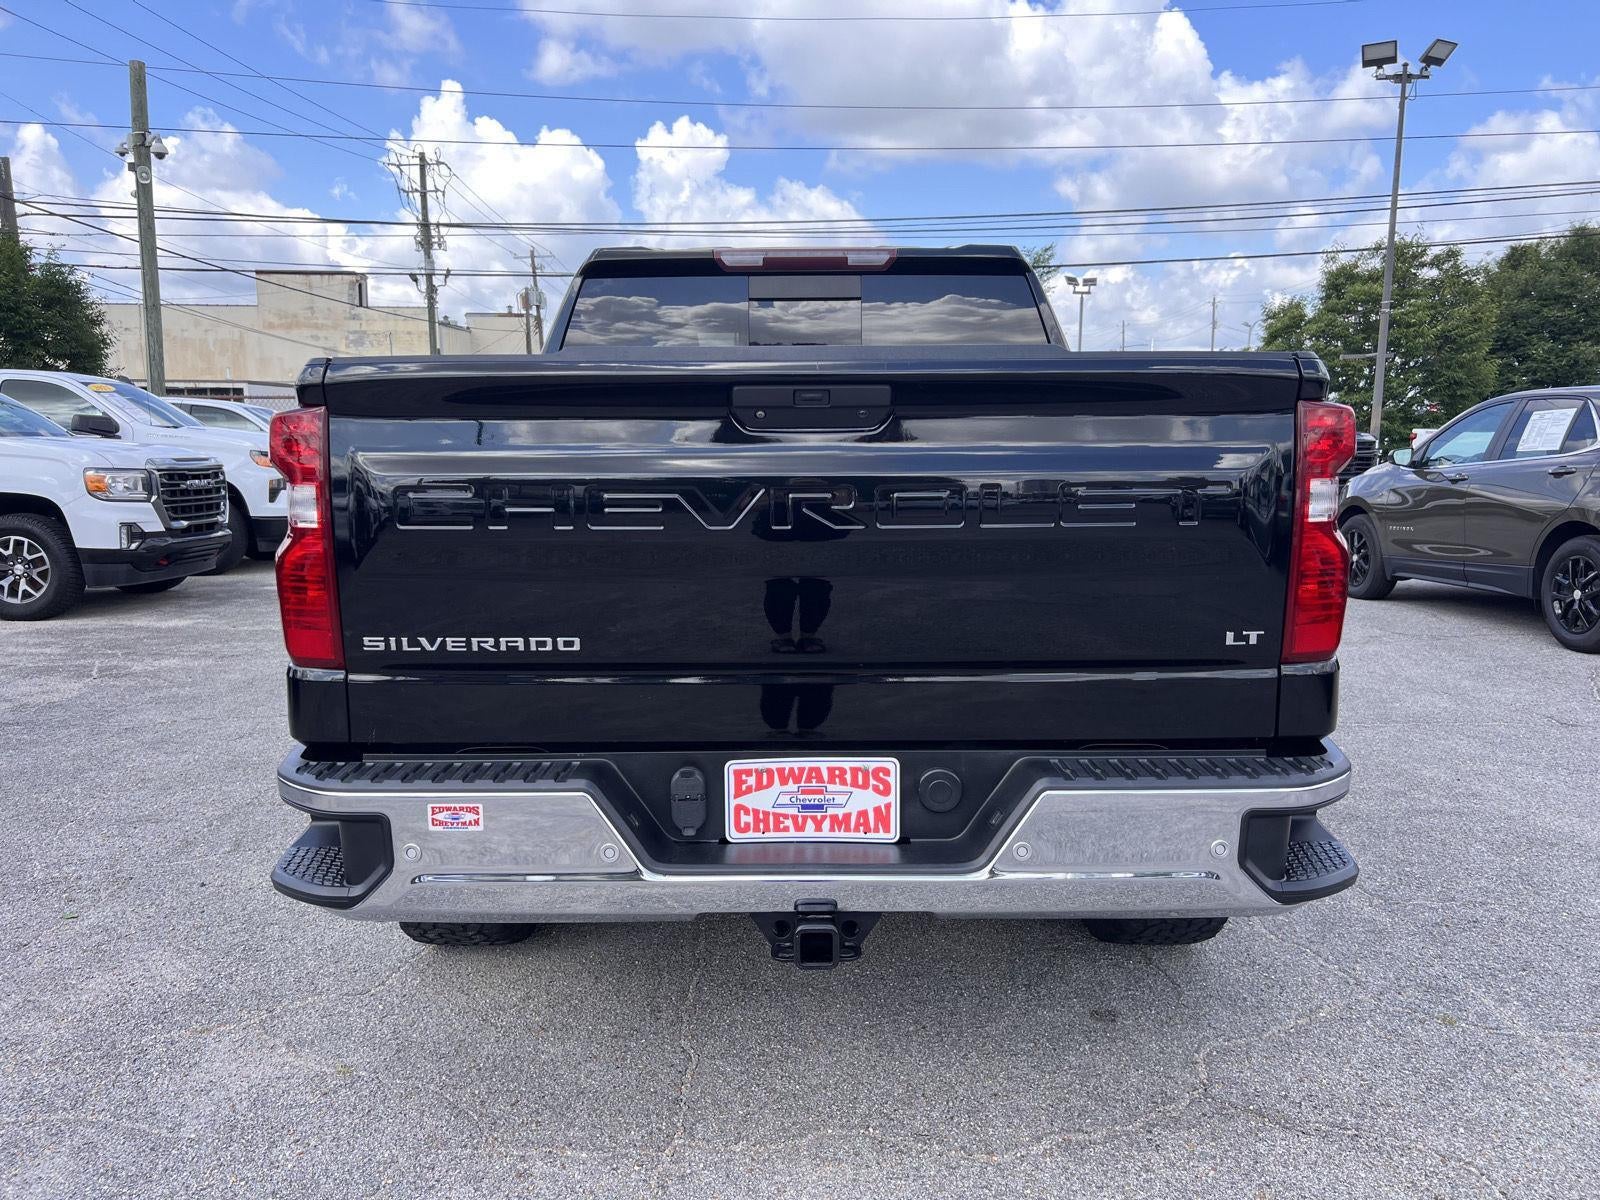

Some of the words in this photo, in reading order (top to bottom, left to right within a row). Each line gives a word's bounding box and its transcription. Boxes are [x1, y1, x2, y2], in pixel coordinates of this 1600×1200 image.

[187, 479, 216, 490] GMC
[394, 483, 1231, 531] CHEVROLET
[362, 636, 581, 652] SILVERADO
[1225, 630, 1265, 646] LT
[732, 765, 892, 798] EDWARDS
[788, 795, 836, 804] Chevrolet
[430, 806, 480, 816] EDWARDS
[732, 802, 892, 834] CHEVYMAN
[430, 817, 480, 827] CHEVYMAN
